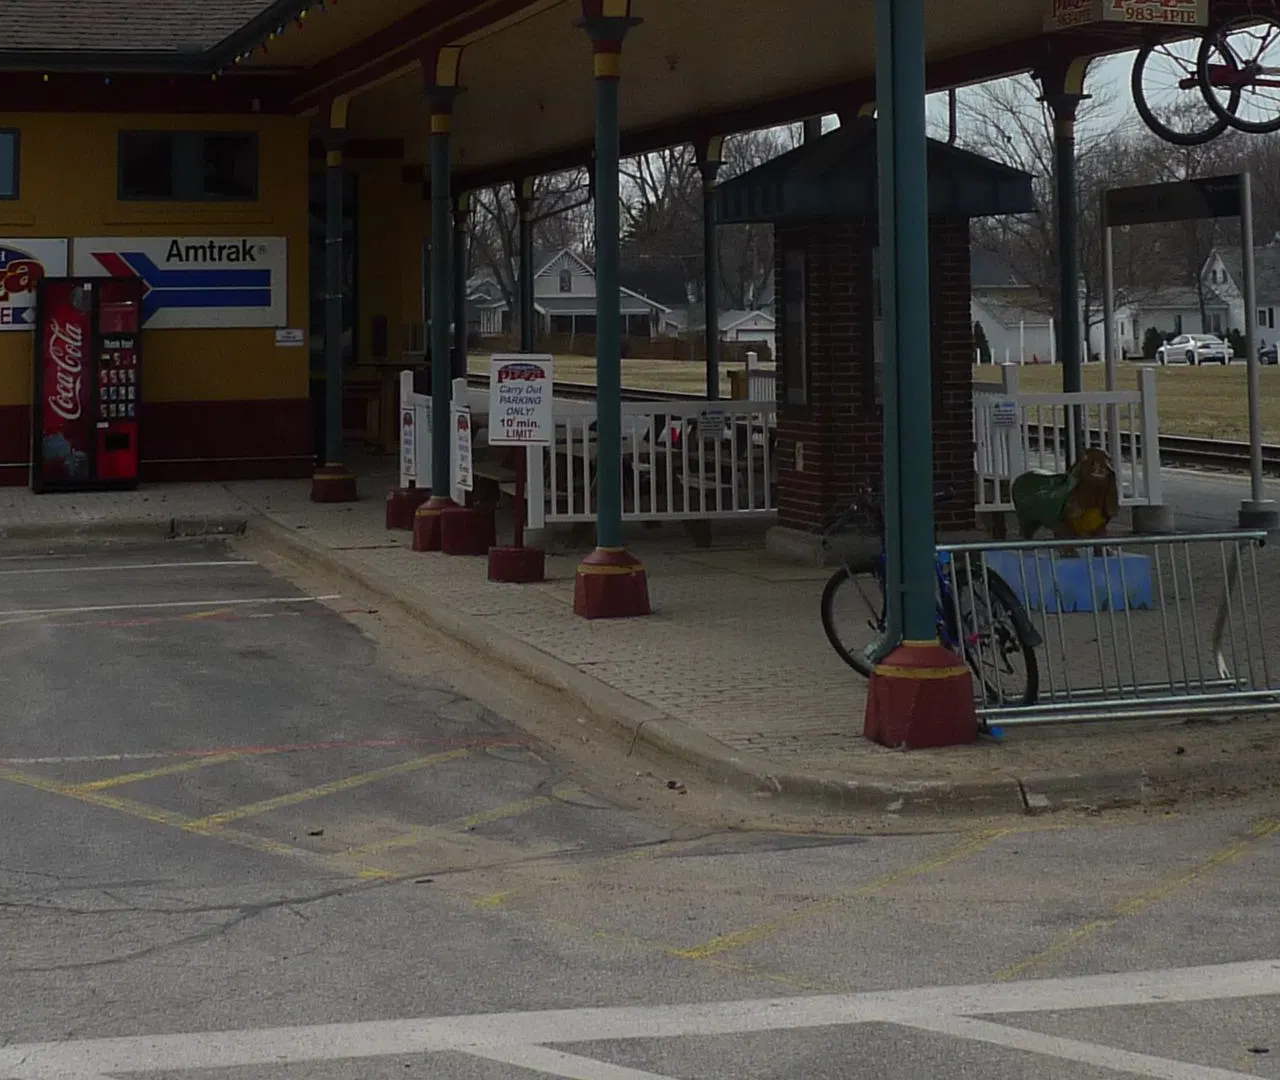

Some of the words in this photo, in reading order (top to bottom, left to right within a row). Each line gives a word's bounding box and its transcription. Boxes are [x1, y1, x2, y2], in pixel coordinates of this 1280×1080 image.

[165, 239, 257, 262] Amtrak
[499, 385, 524, 395] Carry
[499, 396, 542, 405] PARKING
[506, 429, 533, 438] LIMIT
